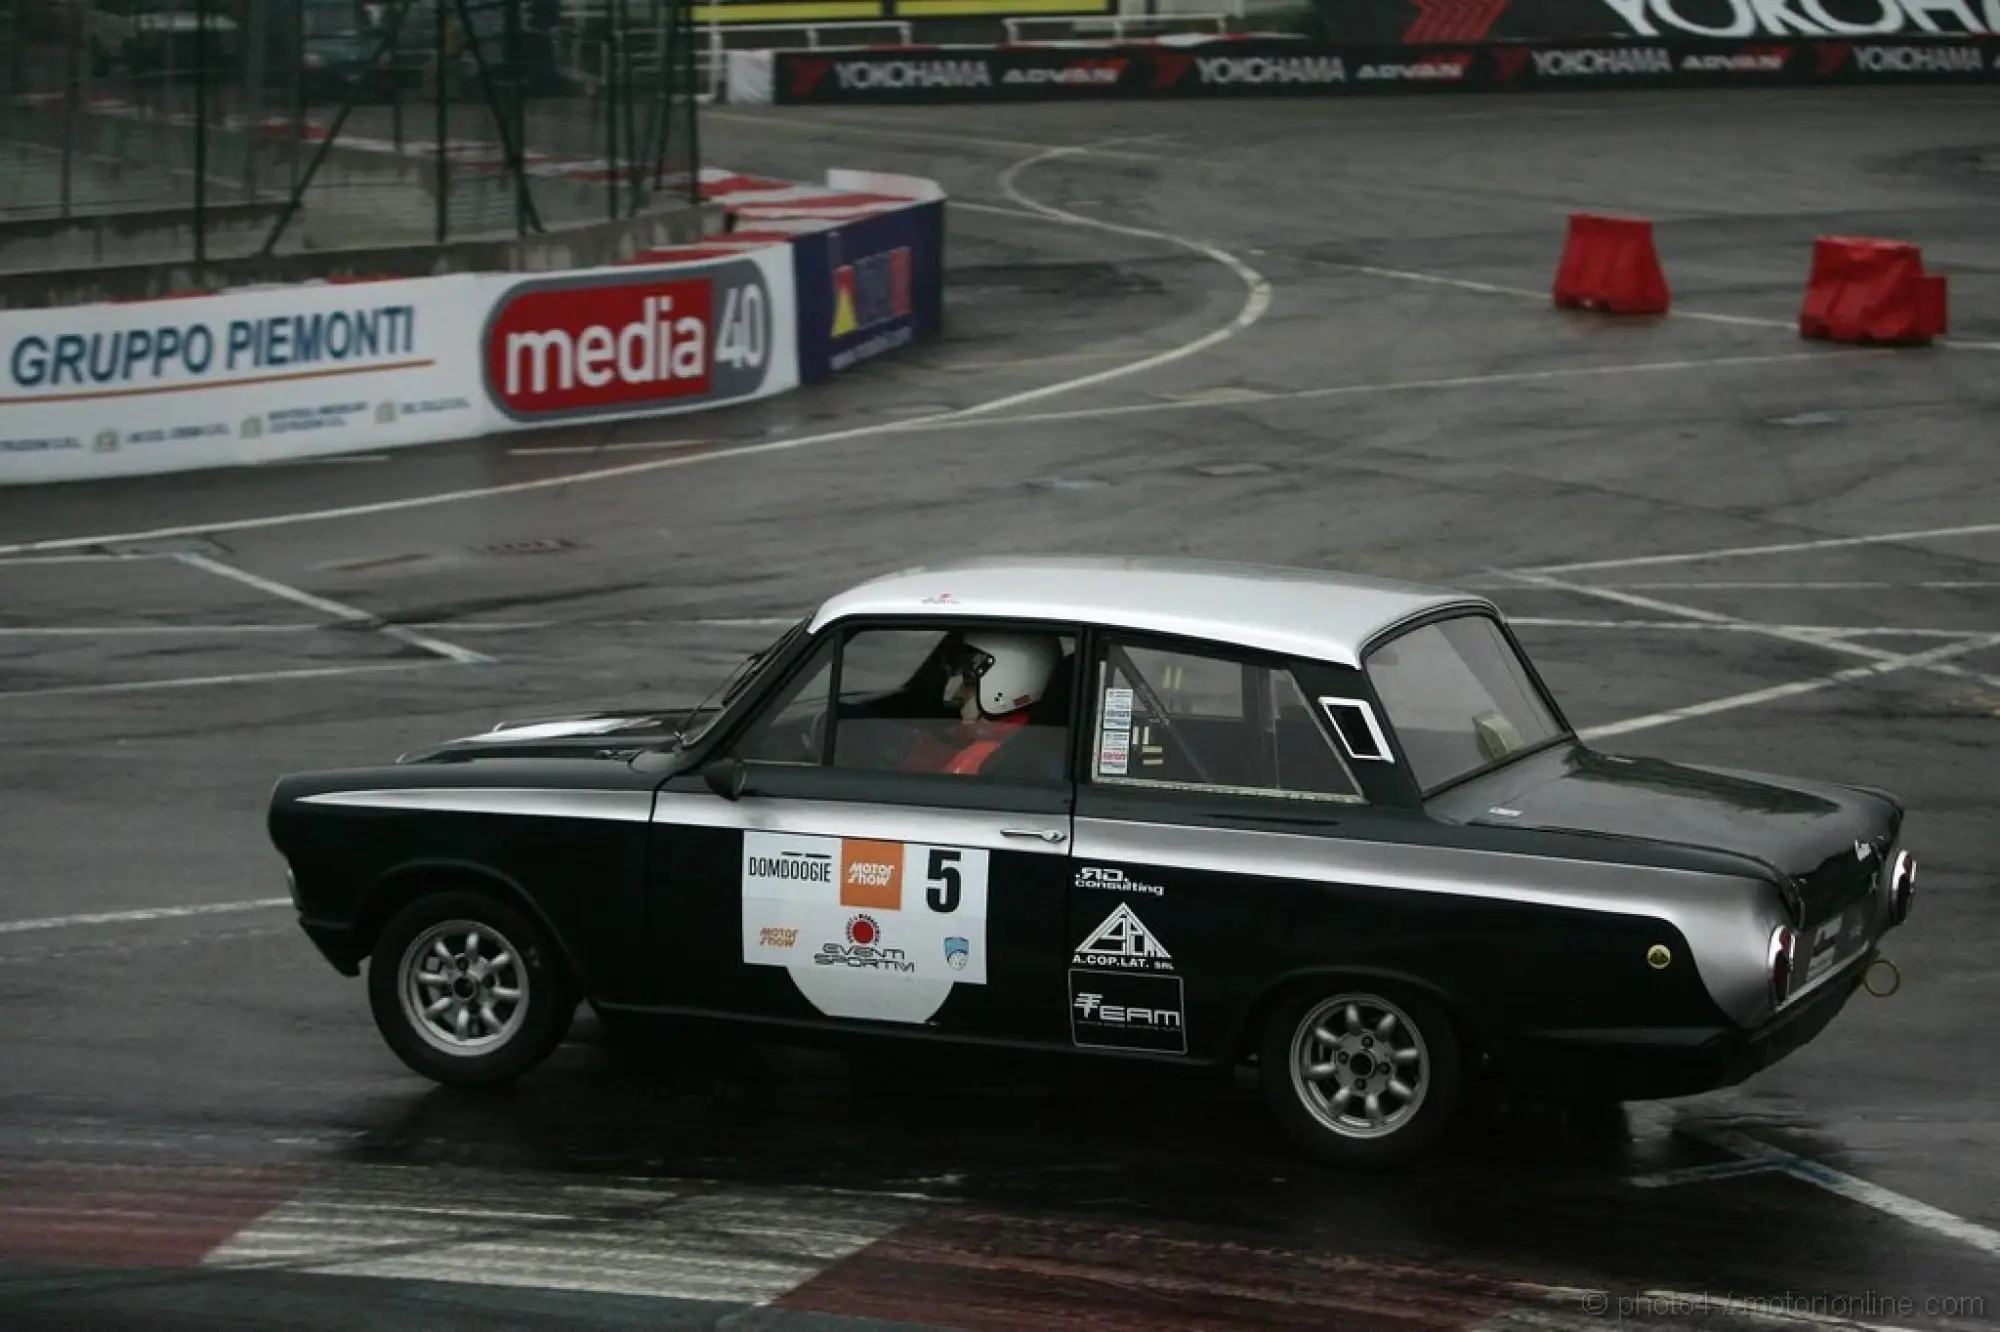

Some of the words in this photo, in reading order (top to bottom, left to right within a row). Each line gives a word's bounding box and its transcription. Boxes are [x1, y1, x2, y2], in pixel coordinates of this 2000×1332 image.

[833, 58, 993, 89] YOKOHAMA
[1002, 66, 1121, 84] ADVAN
[1195, 56, 1347, 84] YOKOHAMA
[1355, 63, 1464, 80] ADVAN
[1532, 48, 1673, 75] YOKOHAMA
[1853, 46, 1983, 72] YOKOHAMA
[11, 323, 214, 388] GRUPPO
[226, 304, 415, 370] PIEMONTI
[505, 296, 706, 395] media
[714, 283, 763, 370] 40
[925, 848, 961, 913] 5
